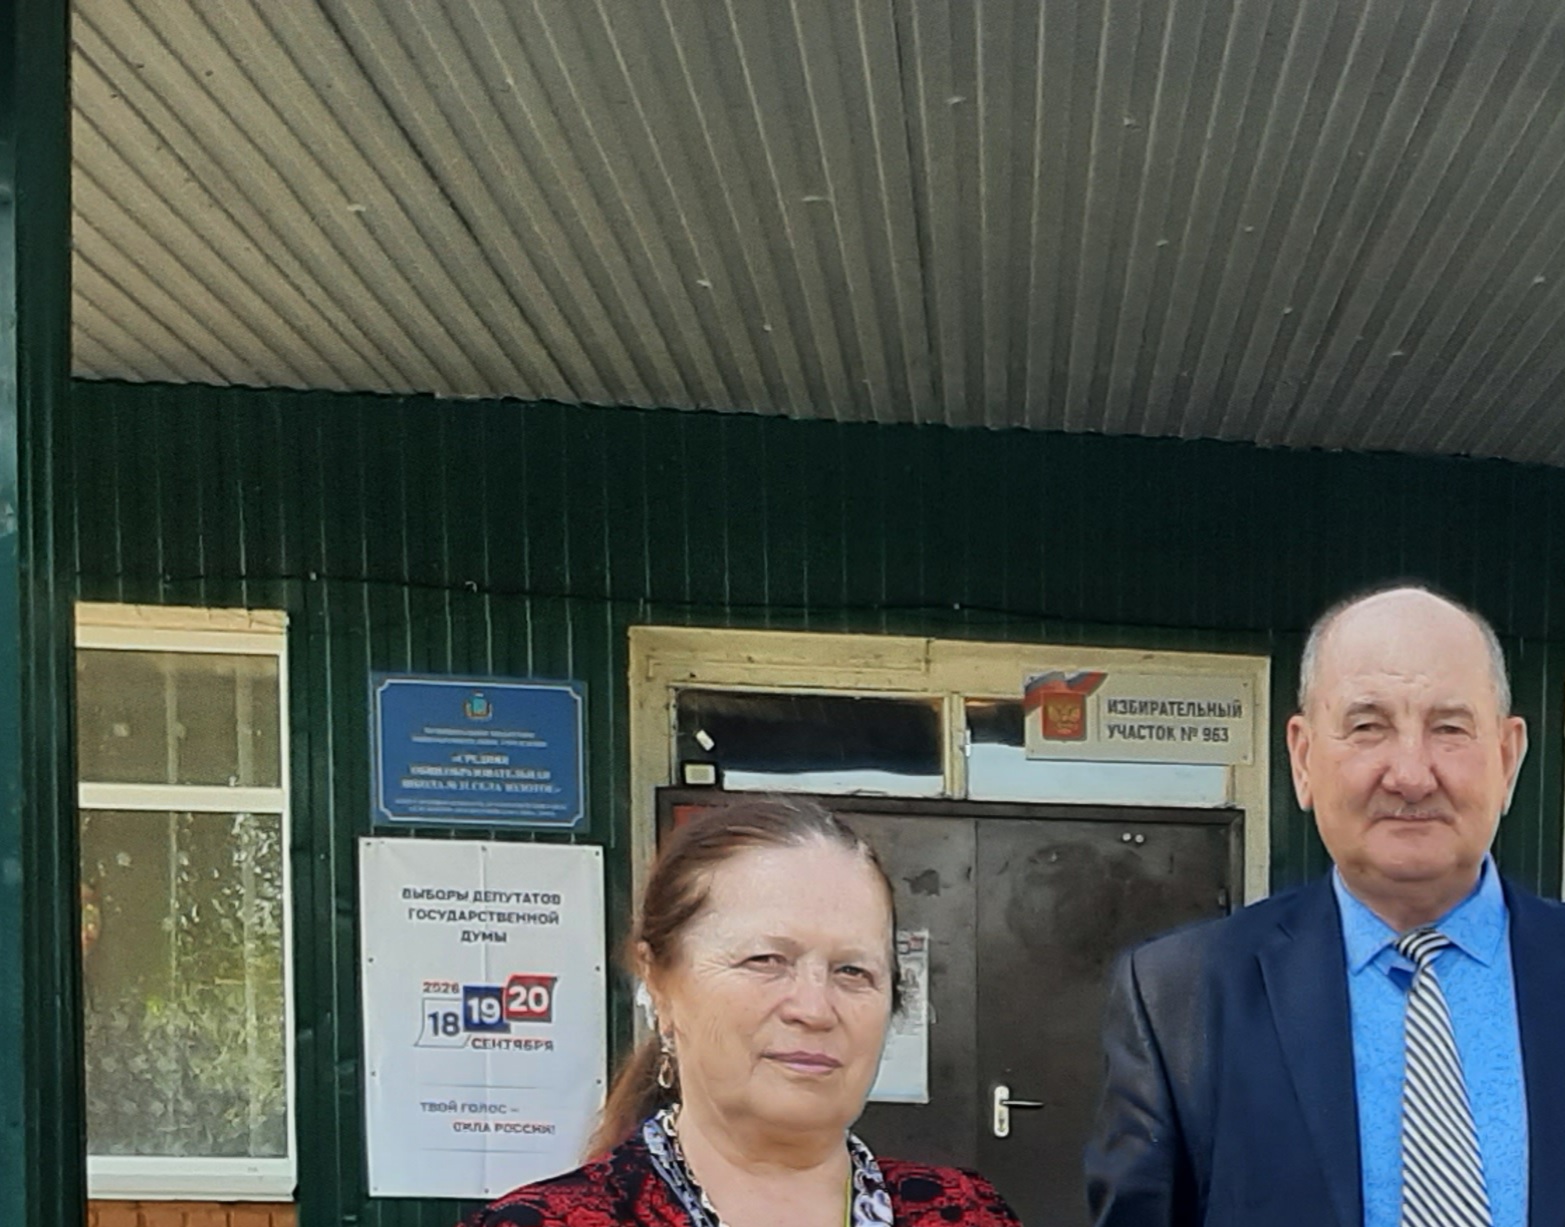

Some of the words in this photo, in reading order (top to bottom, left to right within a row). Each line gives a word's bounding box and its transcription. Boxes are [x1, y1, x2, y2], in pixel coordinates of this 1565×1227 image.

[1107, 699, 1242, 718] ИЗБИРАТЕЛЬНЫЙ
[1107, 725, 1175, 740] УЧАСТОК
[1181, 727, 1198, 740] №
[1202, 728, 1229, 742] 963
[402, 888, 469, 900] ВЫБОРЫ
[472, 890, 561, 905] ДЕПУТАТОВ
[408, 908, 559, 925] ГОСУДАРСТВЕННОЙ
[461, 930, 507, 943] ДУМЫ
[428, 1011, 460, 1036] 18
[468, 997, 501, 1024] 19
[508, 986, 549, 1013] 20
[471, 1037, 554, 1051] СЕНТЯБРЯ
[420, 1100, 457, 1112] ТВОЙ
[461, 1102, 507, 1114] ГОЛОС
[453, 1121, 490, 1133] СИЛА
